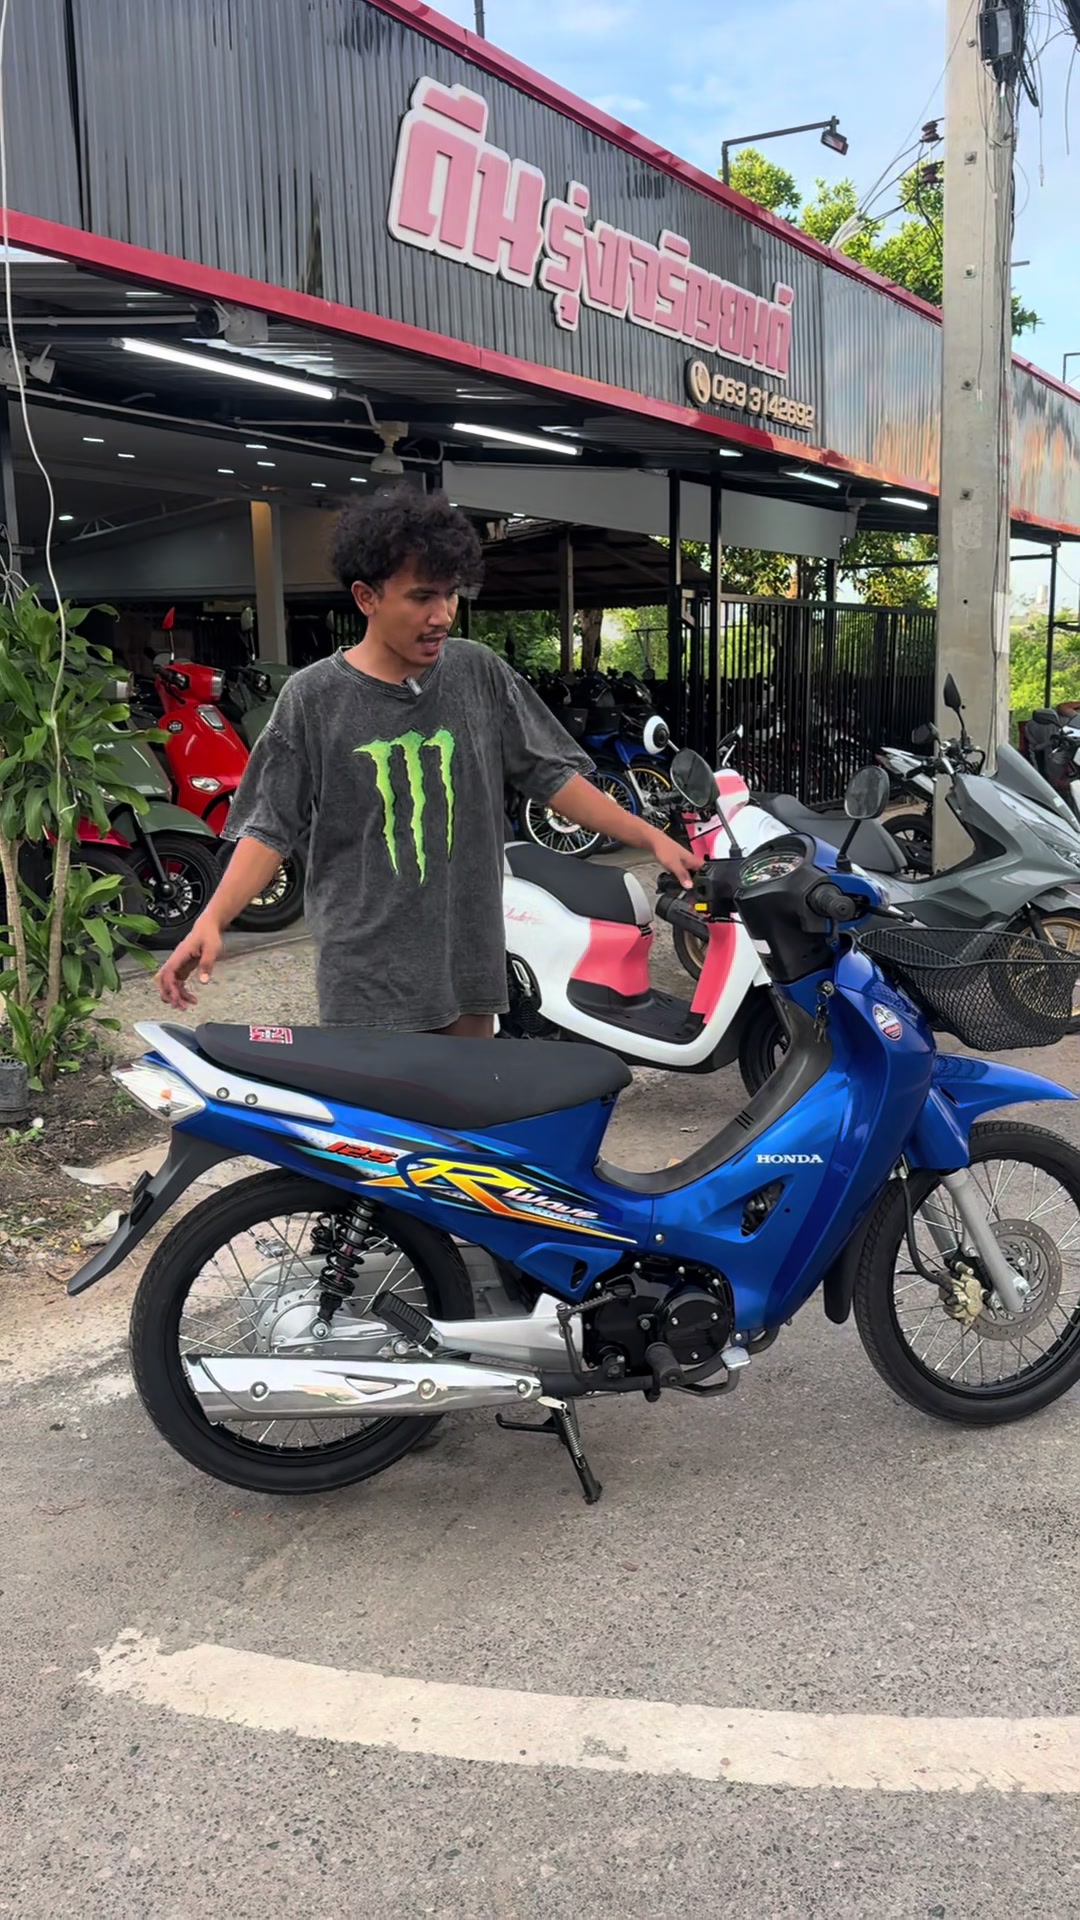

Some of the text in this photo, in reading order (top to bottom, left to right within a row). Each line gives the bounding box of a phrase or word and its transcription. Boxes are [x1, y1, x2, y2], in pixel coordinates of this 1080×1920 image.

[712, 374, 815, 429] 063 3142692
[325, 1141, 399, 1164] 125
[756, 1154, 824, 1164] HONDA
[502, 1187, 600, 1220] Wave
